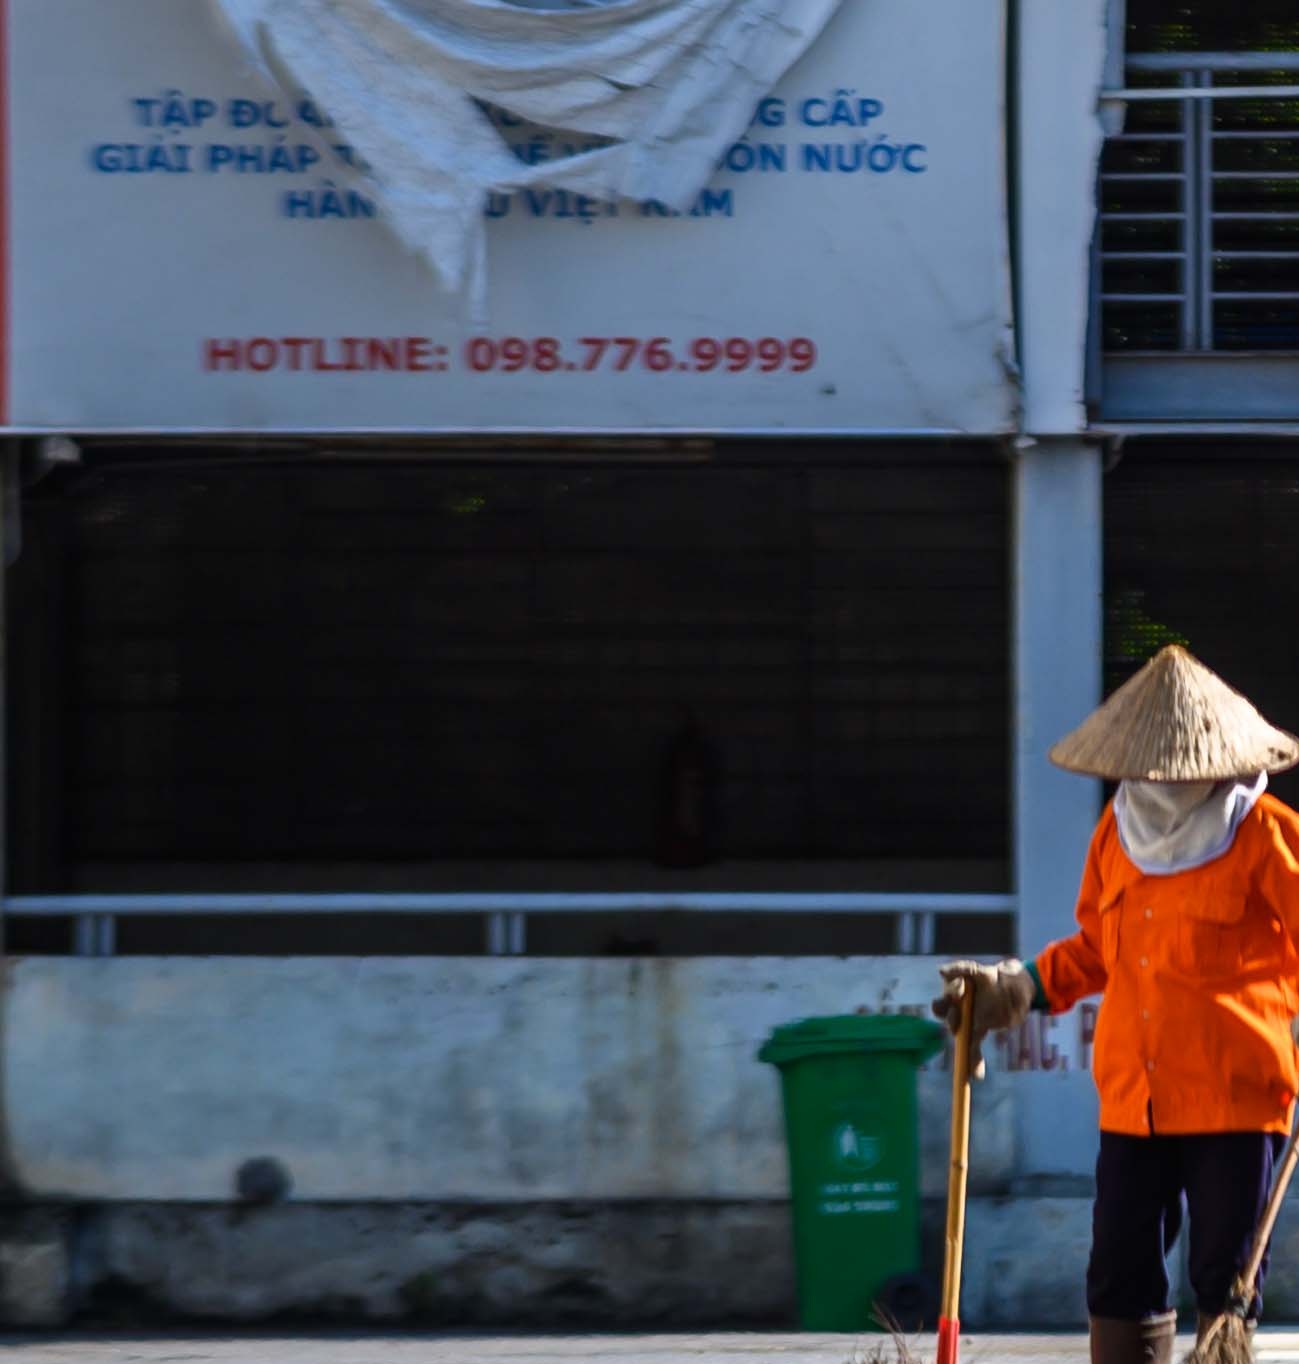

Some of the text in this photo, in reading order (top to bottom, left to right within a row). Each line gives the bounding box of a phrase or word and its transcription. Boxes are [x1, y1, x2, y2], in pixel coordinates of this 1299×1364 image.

[133, 90, 217, 135] TẬP
[801, 89, 884, 127] CẤP
[94, 135, 192, 173] GIẢI
[207, 135, 321, 173] PHÁP
[801, 135, 928, 173] NƯỚC
[283, 179, 377, 218] HÀN
[205, 337, 818, 373] HOTLINE: 098.776.9999
